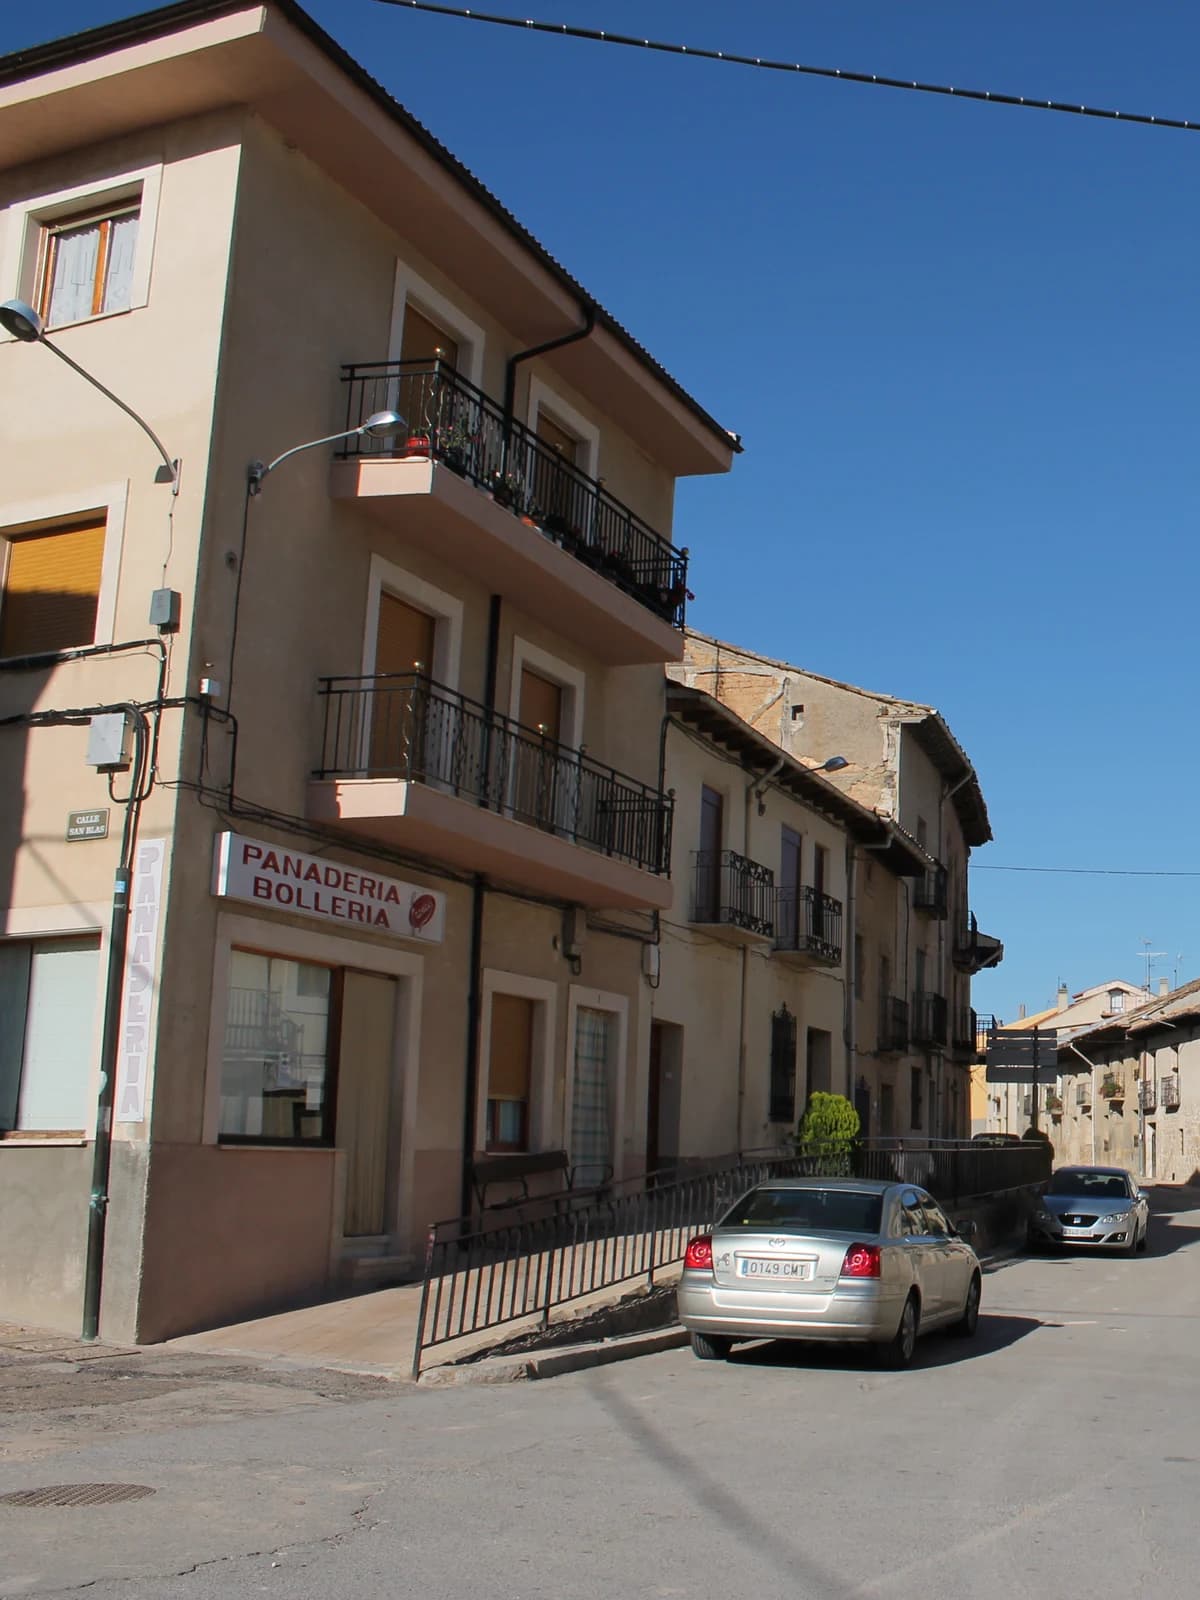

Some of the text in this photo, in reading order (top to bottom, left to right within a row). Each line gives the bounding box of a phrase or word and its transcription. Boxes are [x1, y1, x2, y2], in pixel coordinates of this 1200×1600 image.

[69, 825, 105, 836] SAN BLAS
[76, 815, 100, 825] CALLE
[242, 844, 401, 905] PANADERIA
[252, 876, 390, 929] BOLLERIA
[119, 847, 160, 1114] PANADERIA
[750, 1262, 806, 1277] 0149 CMT
